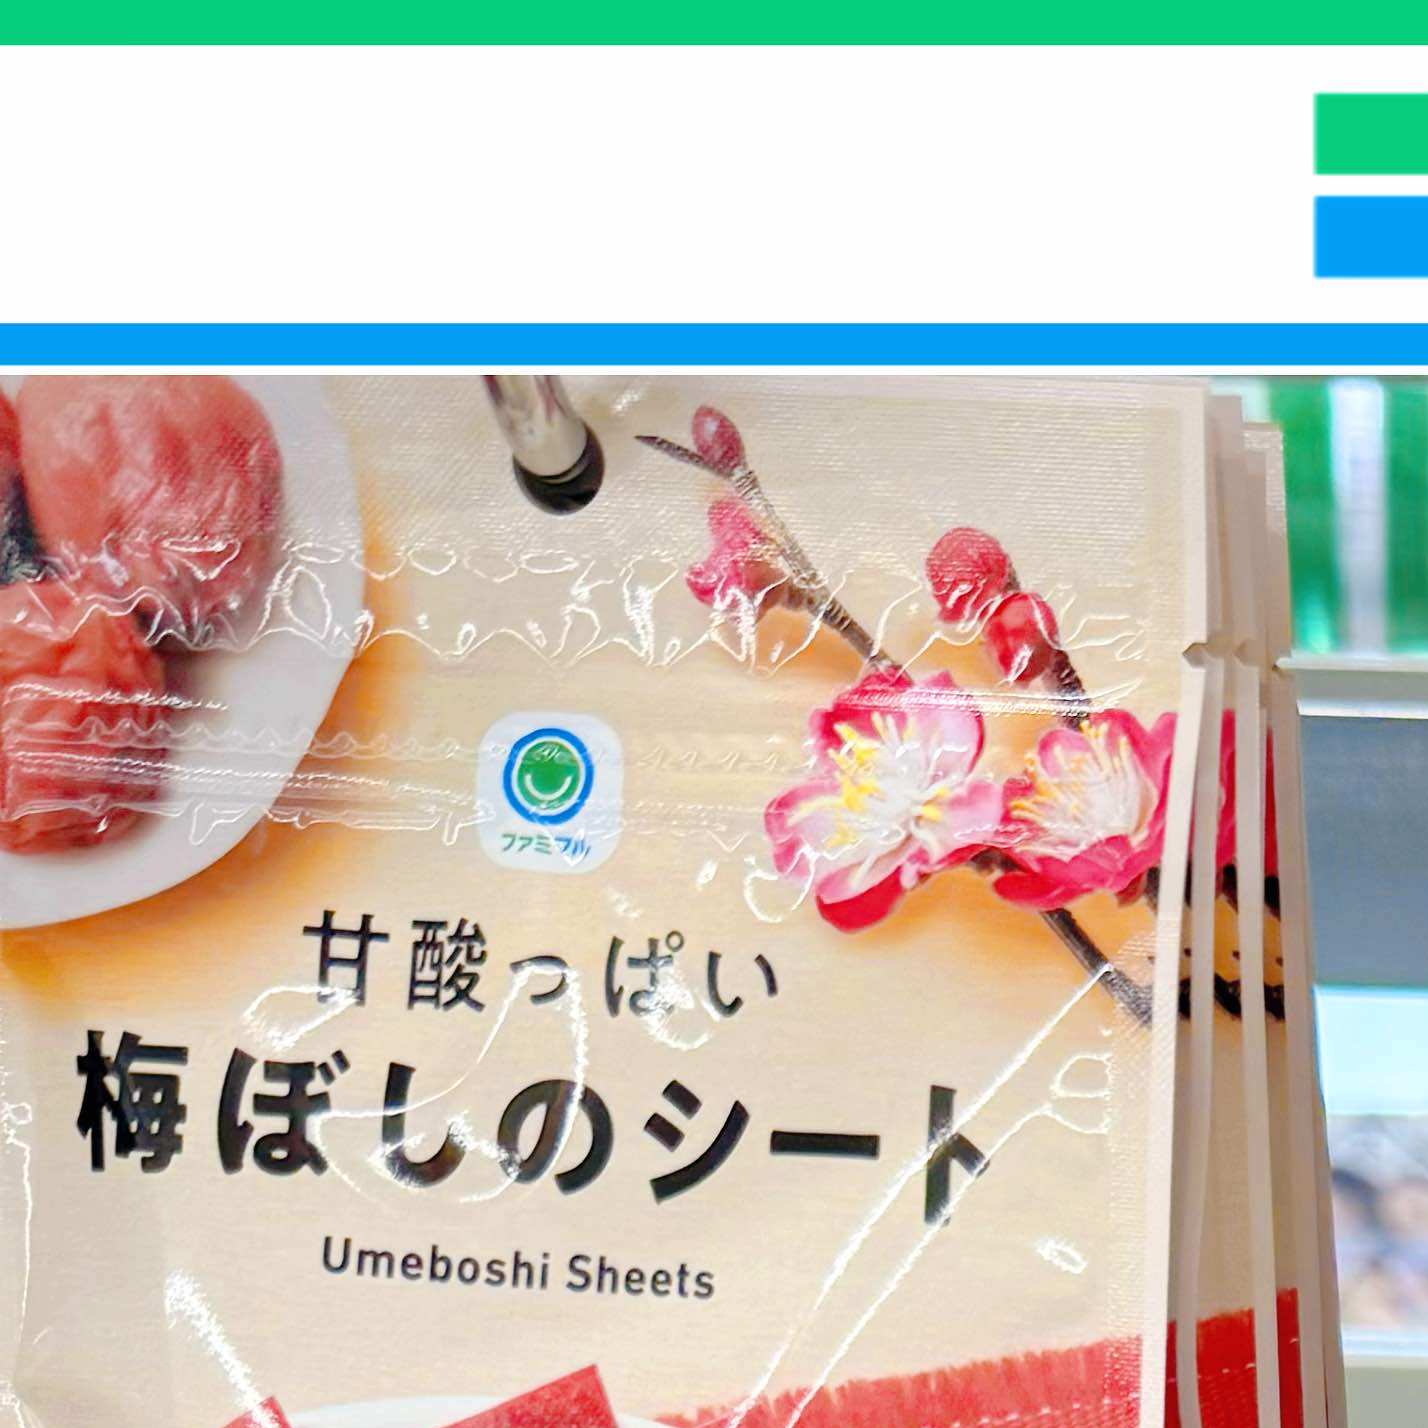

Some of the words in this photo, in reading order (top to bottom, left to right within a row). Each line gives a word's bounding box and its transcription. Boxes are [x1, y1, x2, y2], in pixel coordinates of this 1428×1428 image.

[302, 909, 780, 1020] 甘酸っぱい
[74, 1029, 991, 1226] 梅ぼしのシート
[320, 1236, 551, 1292] Umeboshi
[566, 1250, 716, 1302] Sheets
